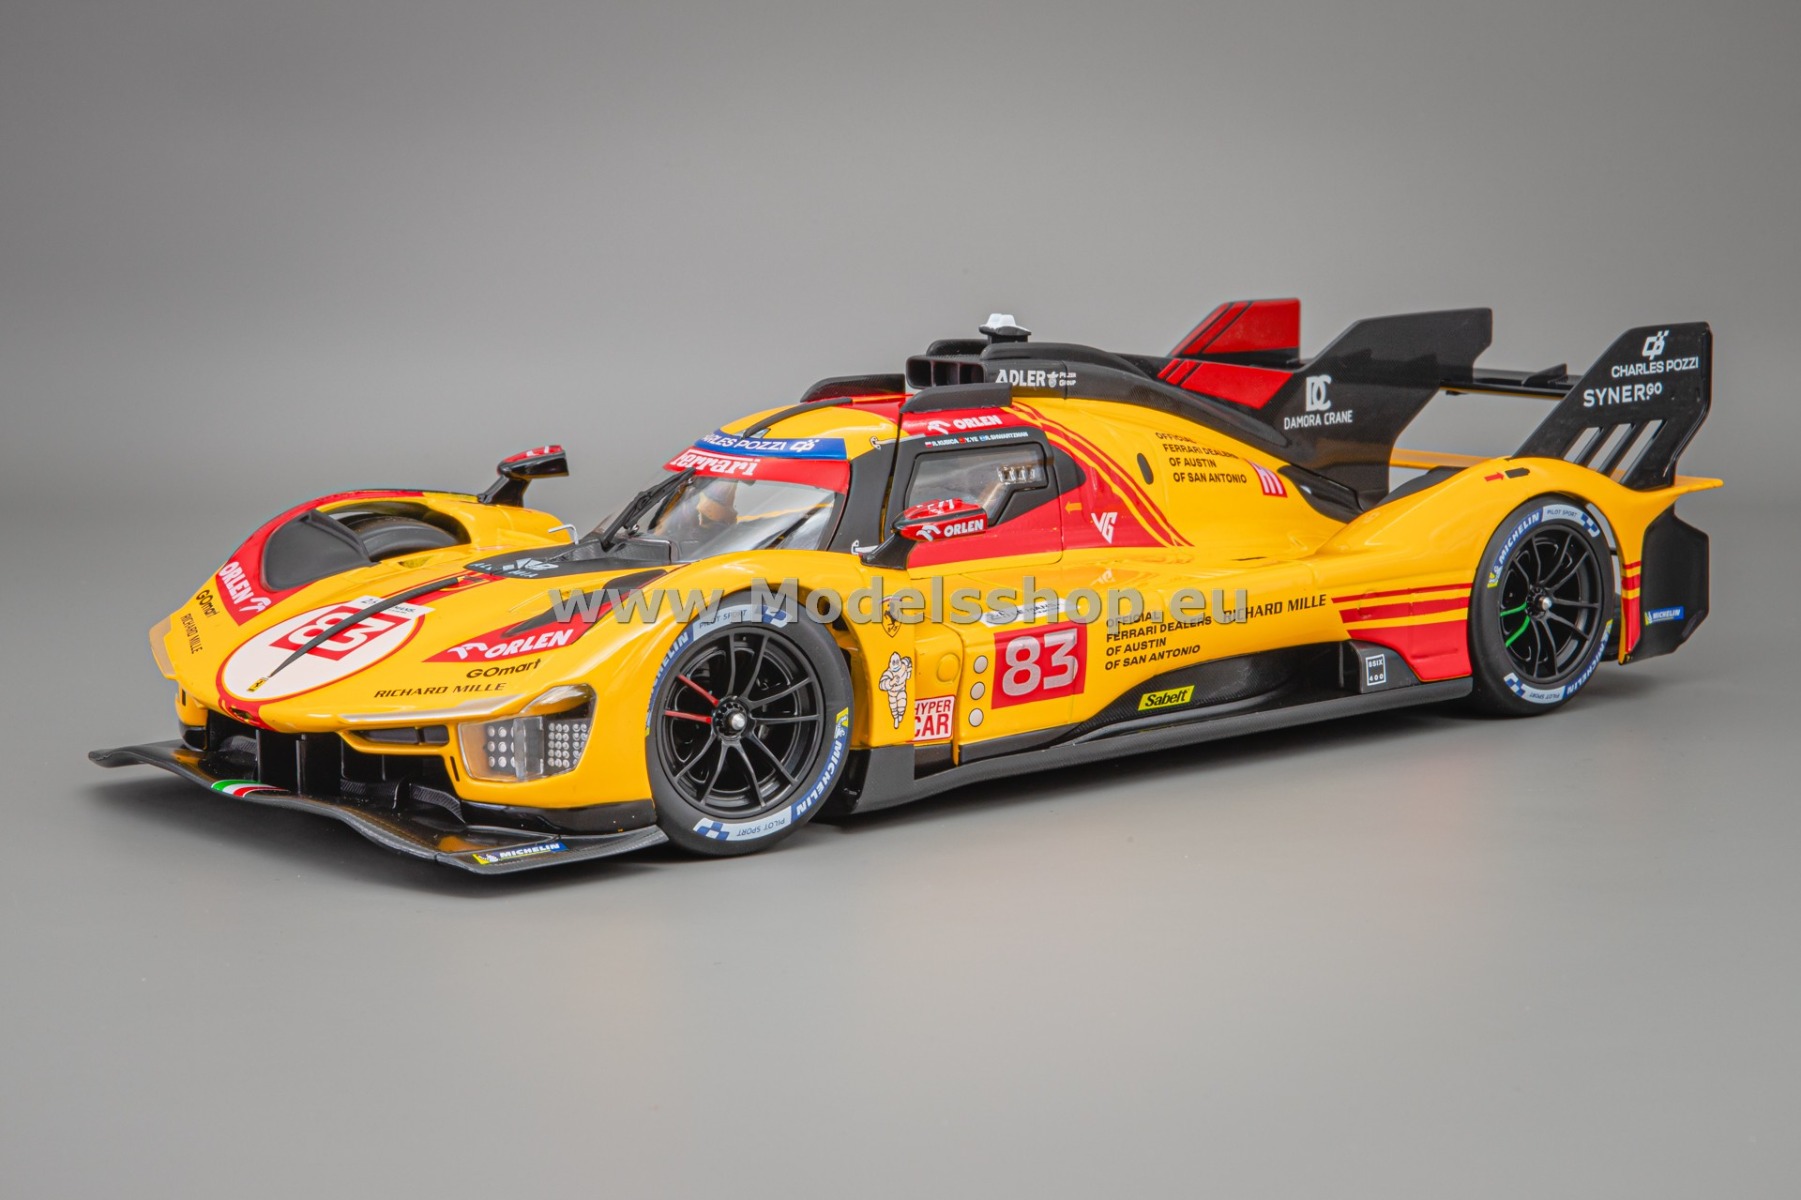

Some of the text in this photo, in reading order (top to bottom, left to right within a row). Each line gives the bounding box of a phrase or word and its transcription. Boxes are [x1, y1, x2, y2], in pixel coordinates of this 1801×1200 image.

[1611, 356, 1699, 378] CHARLES POZZI
[995, 369, 1046, 387] ADLER
[953, 415, 1003, 430] ORLEN
[1284, 410, 1353, 430] DAMORA CRANE
[733, 439, 786, 450] POZZI
[1163, 443, 1202, 454] FERRARI
[671, 449, 761, 476] Ferrari
[1169, 457, 1217, 468] OF AUSTIN
[1173, 472, 1247, 483] OF SAN ANTONIO
[1562, 509, 1578, 517] SPORT
[944, 519, 984, 537] ORLEN
[1498, 511, 1540, 565] MICHELIN
[218, 561, 254, 605] ORLEN
[1223, 594, 1327, 623] RICHARD MILLE
[1106, 611, 1161, 628] OFFICIAL
[1106, 616, 1212, 642] FERRARI DEALERS
[288, 612, 397, 652] 83
[485, 629, 573, 658] ORLEN
[1106, 637, 1166, 657] OF AUSTIN
[466, 658, 541, 678] GOmart
[1002, 628, 1078, 696] 83
[1105, 645, 1200, 671] OF SAN ANTONIO
[1567, 638, 1608, 695] MICHELIN
[374, 682, 507, 698] RICHARD MILLE
[1145, 689, 1188, 707] Sabelt
[914, 699, 951, 716] HYPER
[796, 740, 843, 816] MICHELIN
[736, 818, 785, 837] PILOT SPORT
[500, 843, 560, 858] MICHELIN
